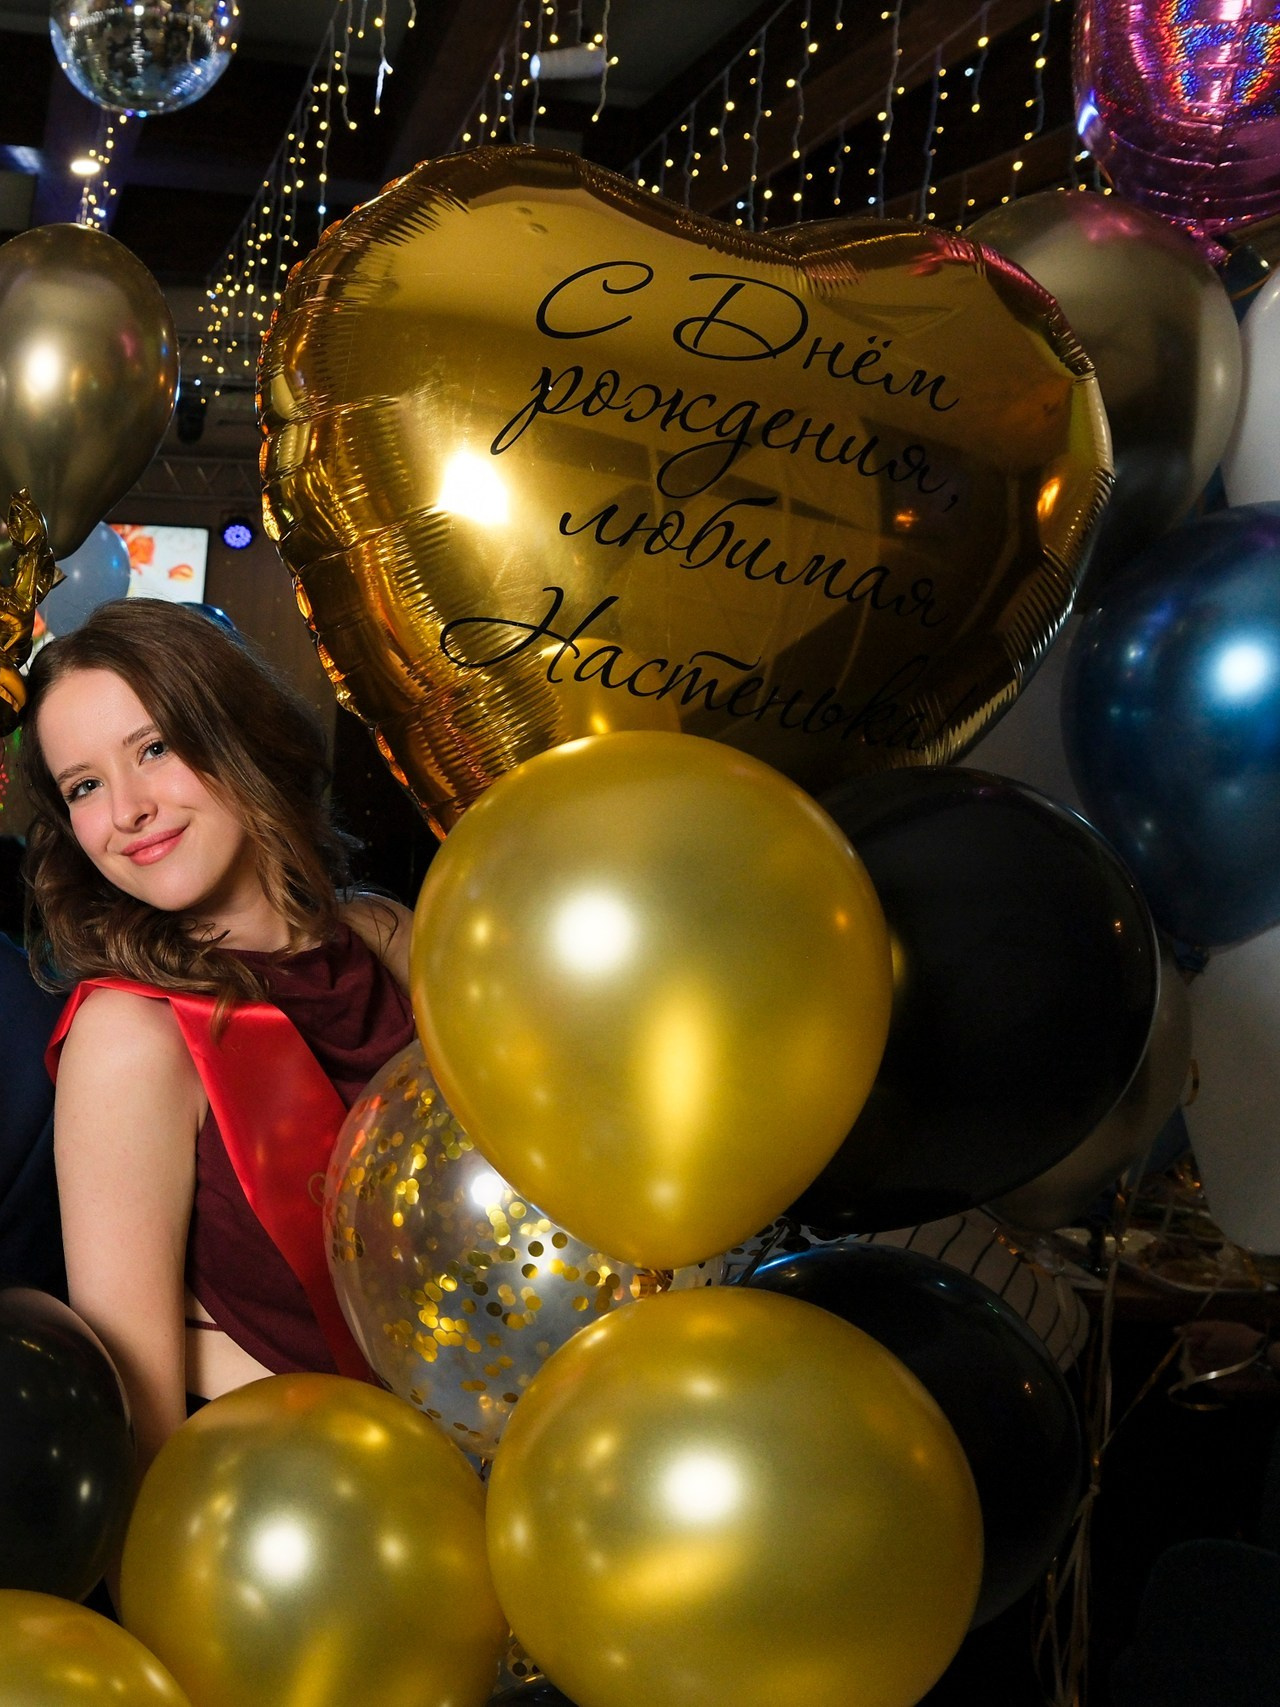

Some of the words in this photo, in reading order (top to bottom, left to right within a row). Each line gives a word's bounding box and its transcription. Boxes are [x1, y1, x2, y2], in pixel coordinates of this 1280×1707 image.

[535, 261, 654, 341] С
[671, 272, 960, 412] Днём
[490, 365, 960, 513] рождения,
[558, 496, 950, 627] любимая
